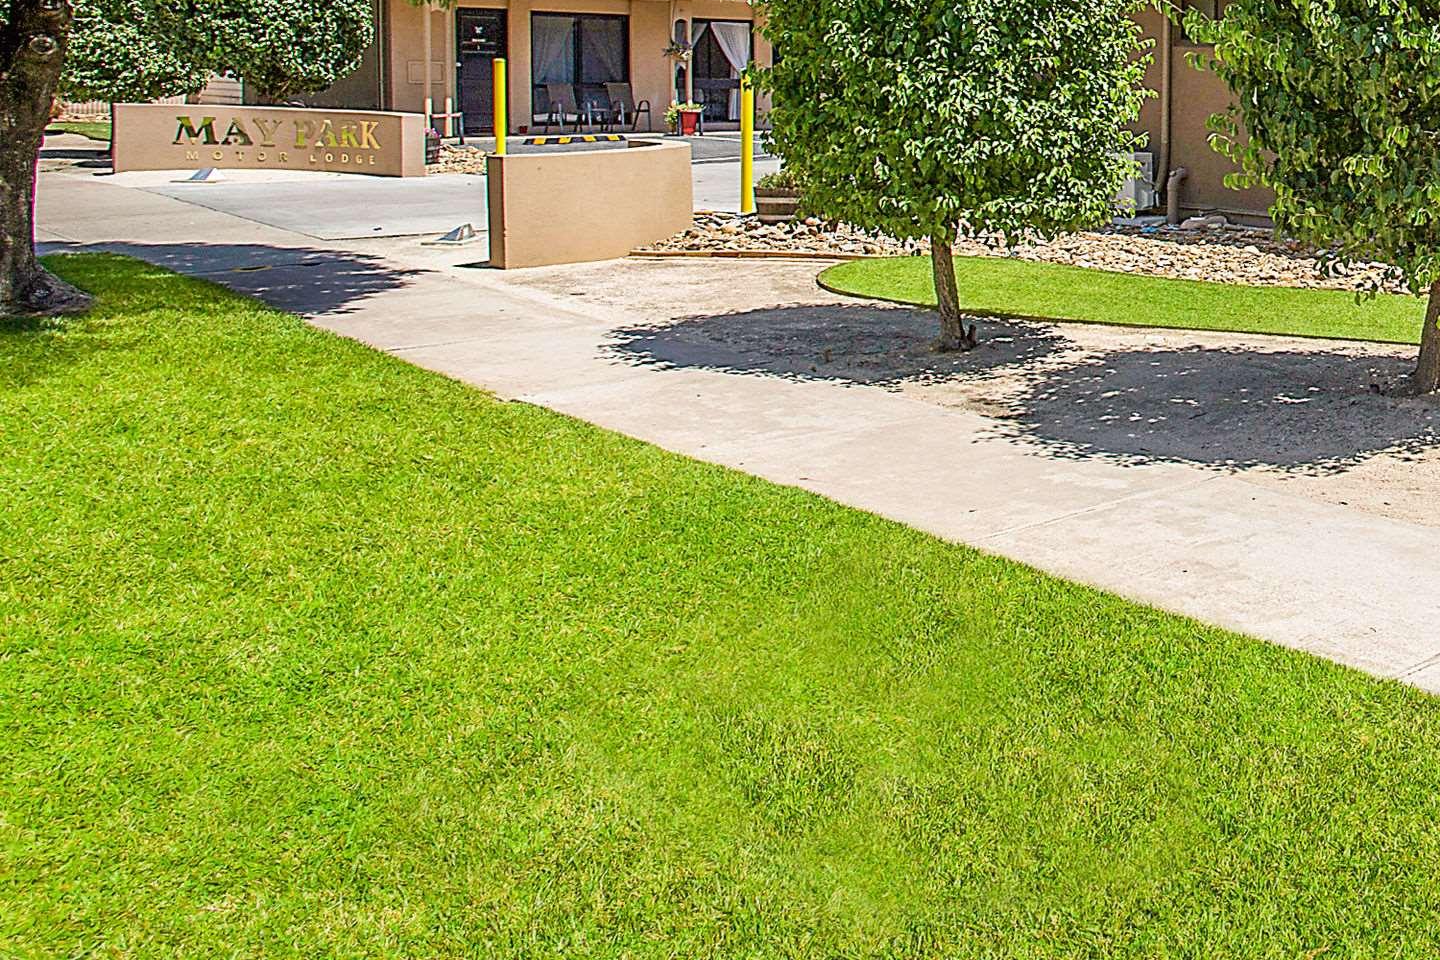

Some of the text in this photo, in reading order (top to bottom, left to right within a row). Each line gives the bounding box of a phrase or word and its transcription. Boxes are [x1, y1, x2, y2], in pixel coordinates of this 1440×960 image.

[172, 116, 381, 150] MAY PARK
[186, 151, 376, 165] MOTOR LODGE
